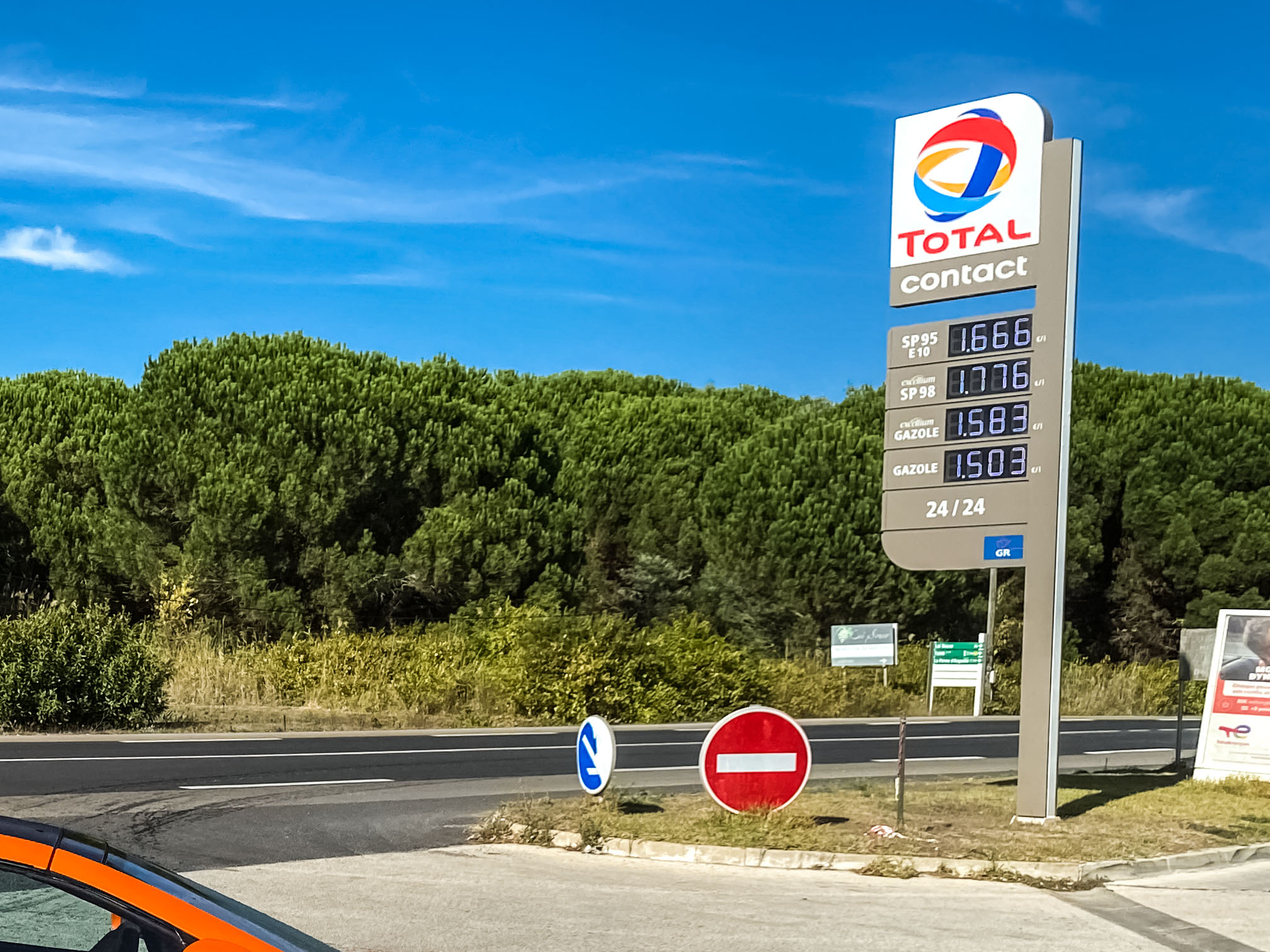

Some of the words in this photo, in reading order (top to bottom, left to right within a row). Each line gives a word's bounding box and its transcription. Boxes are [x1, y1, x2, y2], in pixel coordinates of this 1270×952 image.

[897, 219, 1032, 258] TOTAL
[900, 255, 1028, 294] contact
[961, 317, 1030, 352] 1.666
[959, 360, 1028, 394] 1.776
[893, 426, 940, 441] GAZOLE
[958, 404, 1028, 437] 1.583
[892, 462, 939, 477] GAZOLE
[956, 447, 1026, 479] 1.503
[995, 549, 1011, 557] GR
